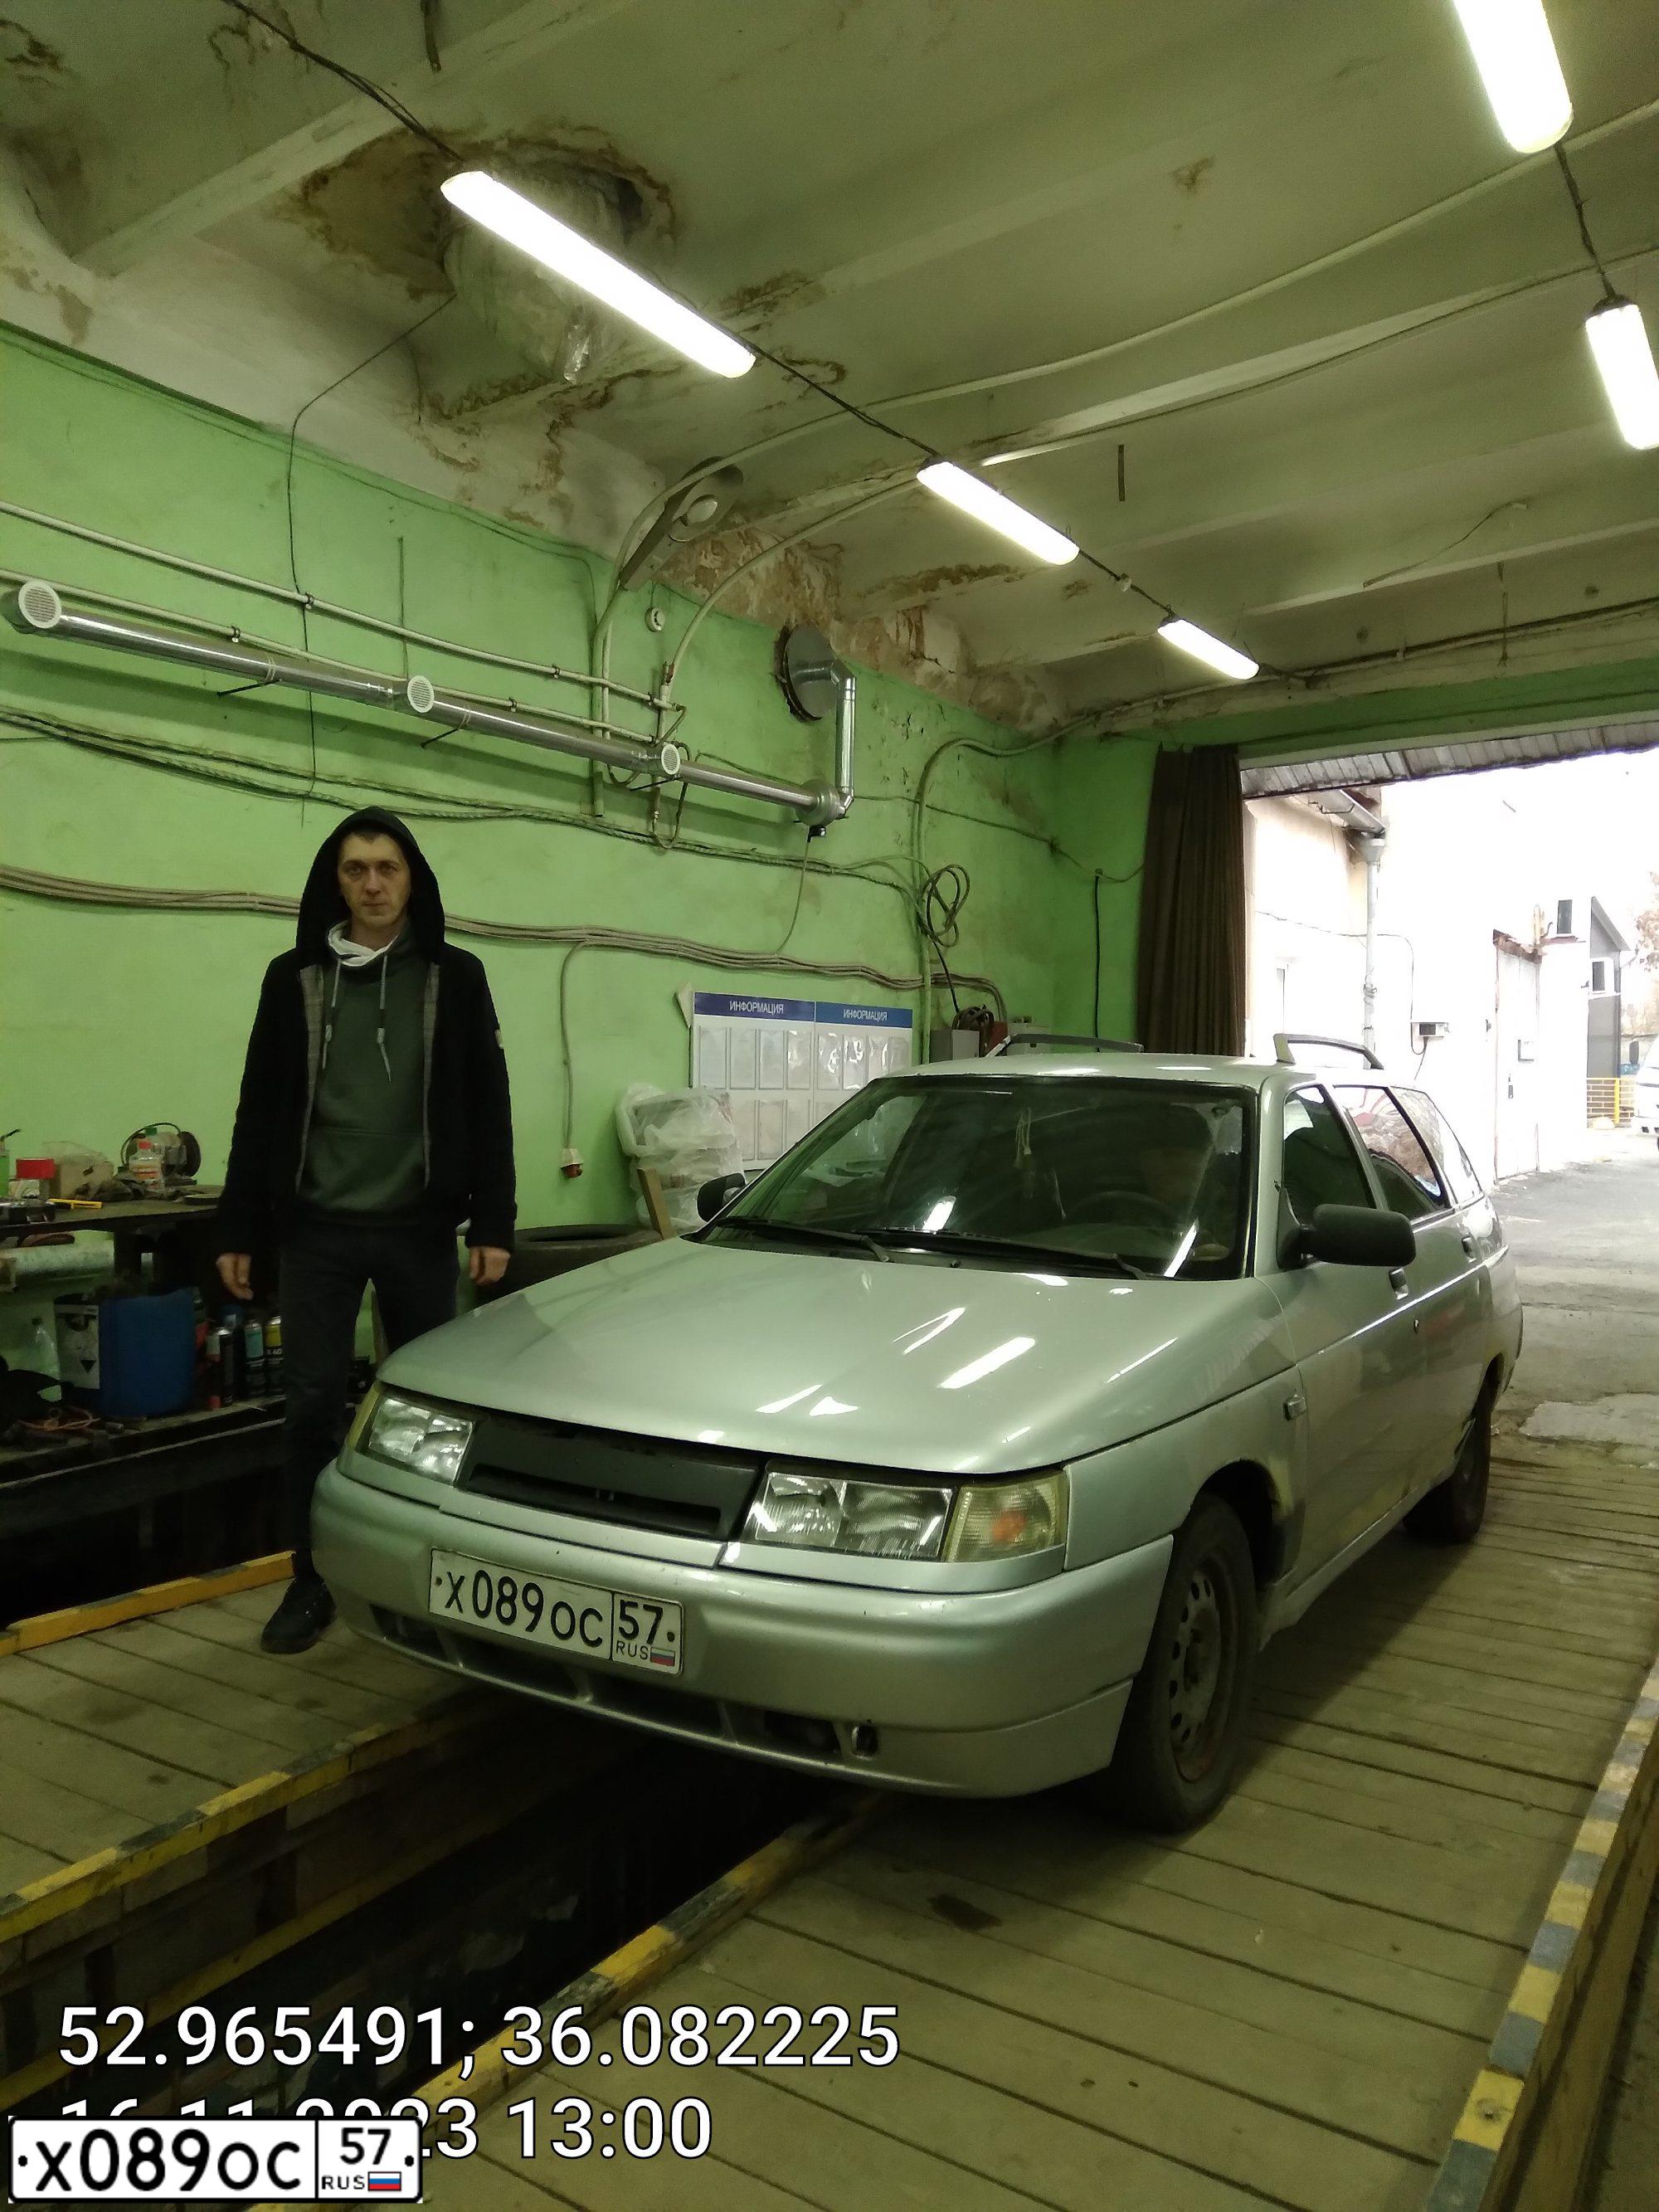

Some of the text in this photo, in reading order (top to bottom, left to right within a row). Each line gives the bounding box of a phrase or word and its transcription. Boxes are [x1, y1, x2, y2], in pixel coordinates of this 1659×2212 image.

[729, 1000, 784, 1016] ИНФОРМАЦИЯ
[843, 1008, 888, 1023] ИНФОРМАЦИЯ
[618, 1599, 664, 1645] 57
[615, 1640, 649, 1660] RUS
